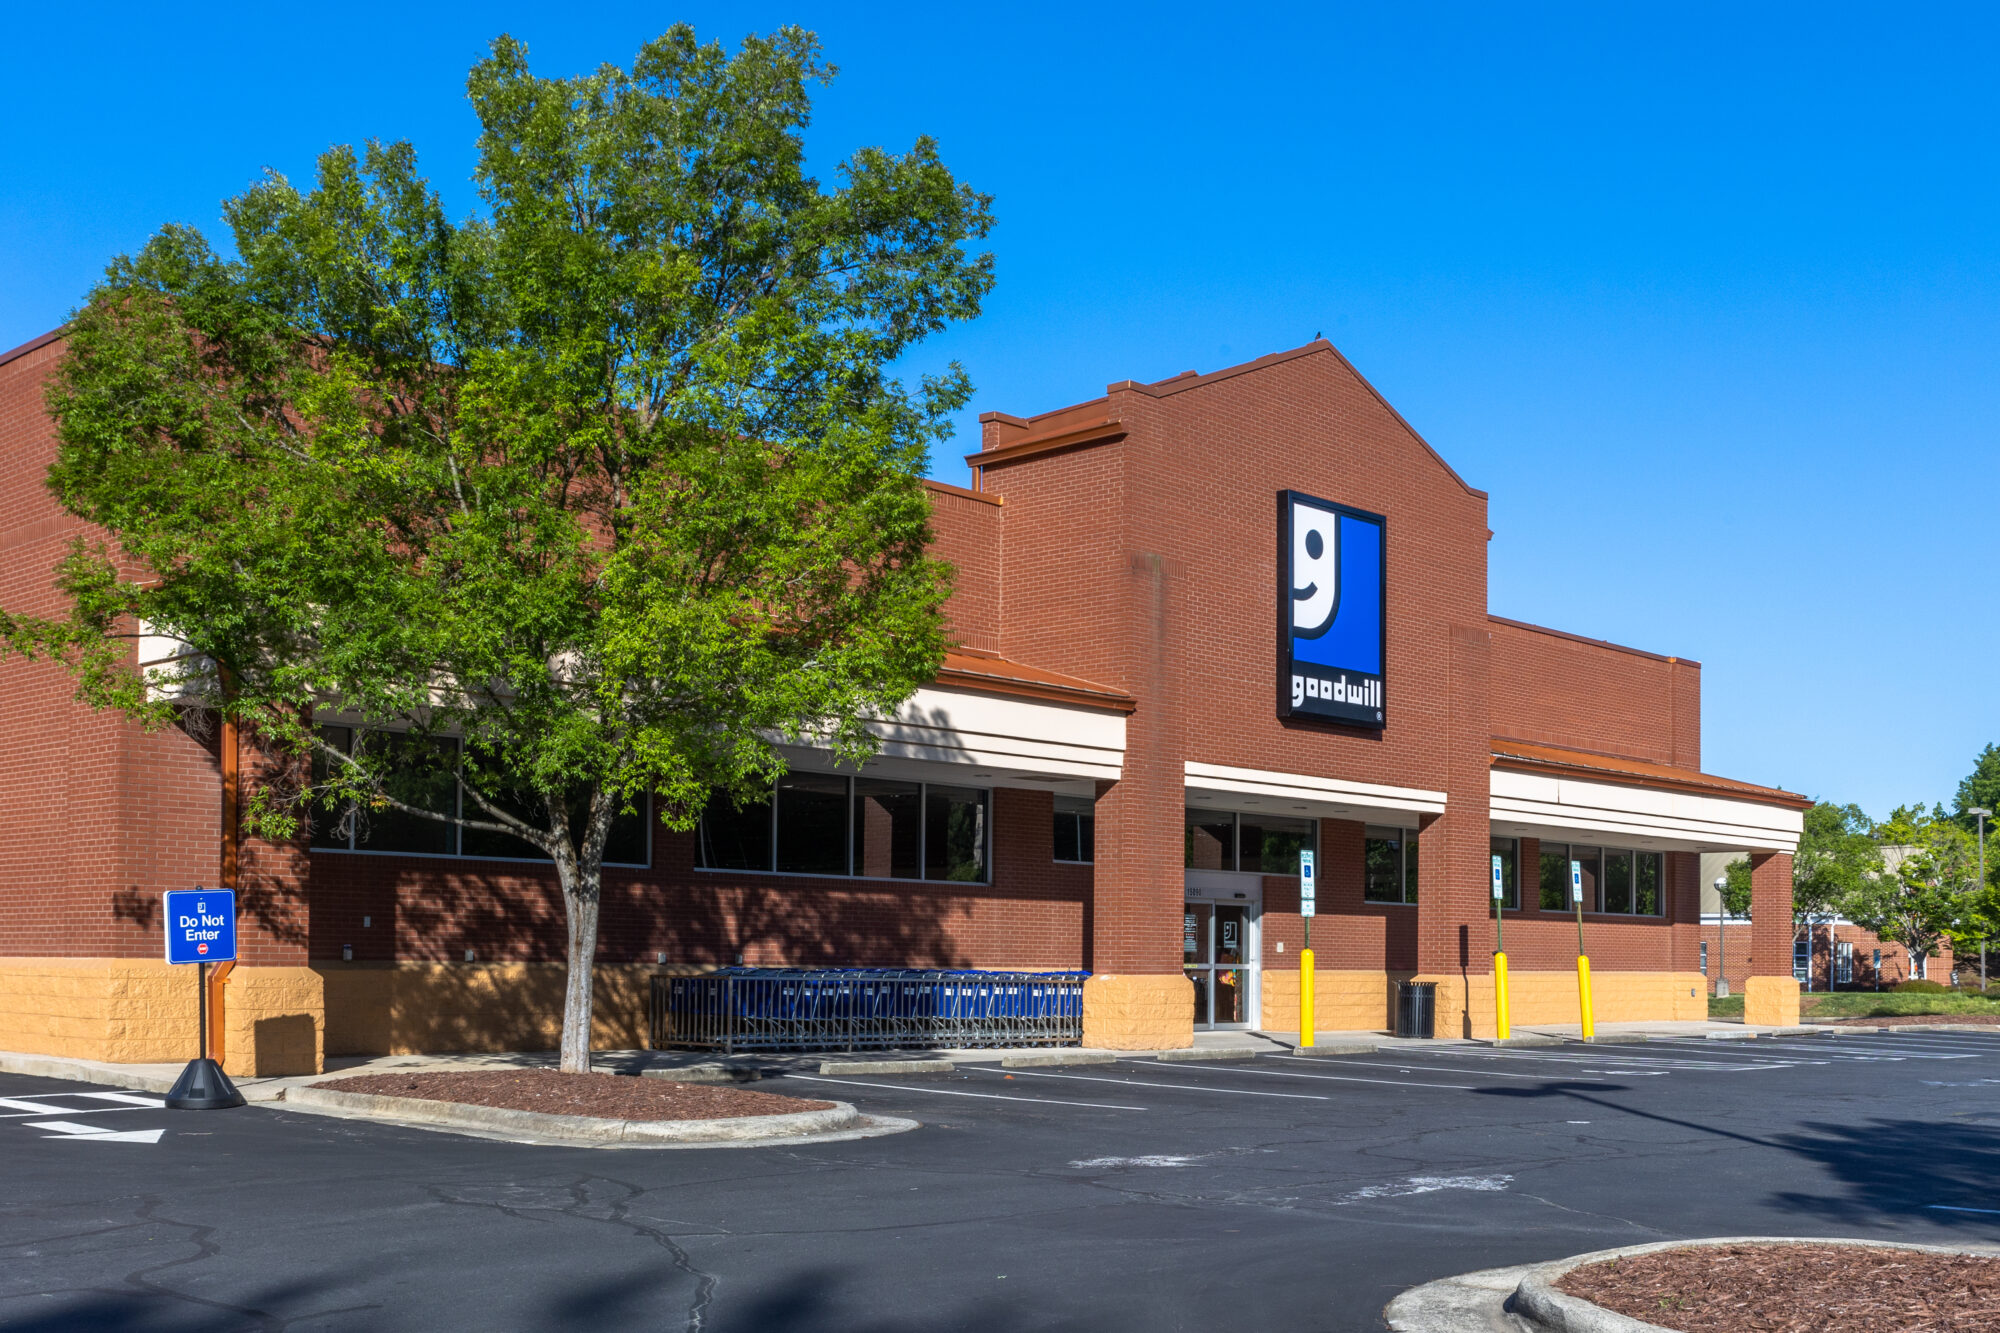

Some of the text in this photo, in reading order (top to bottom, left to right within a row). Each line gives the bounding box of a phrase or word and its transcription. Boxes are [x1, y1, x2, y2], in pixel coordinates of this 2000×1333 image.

[1292, 674, 1381, 708] goodwill
[179, 914, 225, 928] Do Not
[185, 928, 220, 942] Enter
